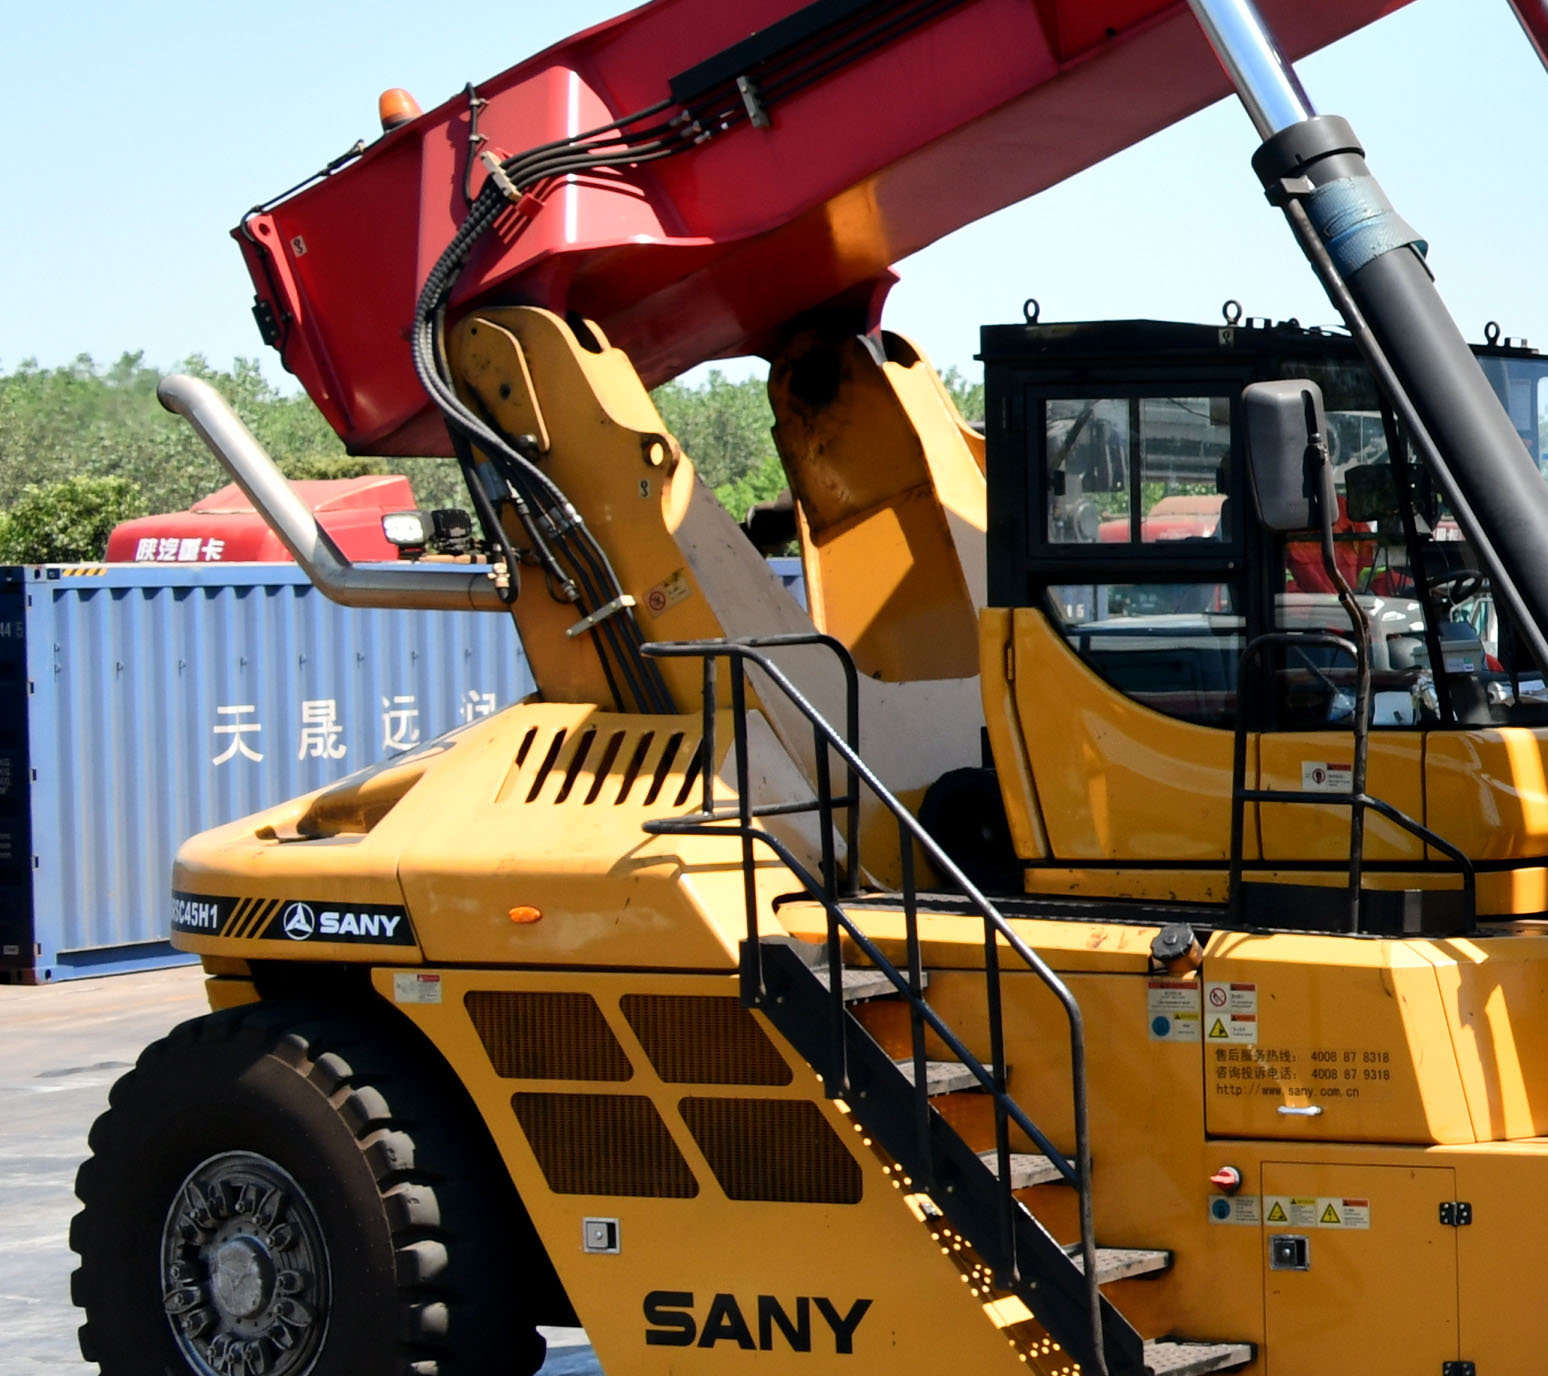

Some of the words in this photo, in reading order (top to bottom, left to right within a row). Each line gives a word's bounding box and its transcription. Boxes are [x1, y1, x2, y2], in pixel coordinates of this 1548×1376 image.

[320, 912, 401, 937] SANY
[1311, 1051, 1337, 1063] 4008
[1343, 1051, 1357, 1063] 87
[1363, 1051, 1390, 1063] 8318
[1312, 1068, 1338, 1080] 4008
[1344, 1069, 1357, 1080] 87
[1364, 1069, 1390, 1081] 9318
[642, 1290, 873, 1355] SANY
